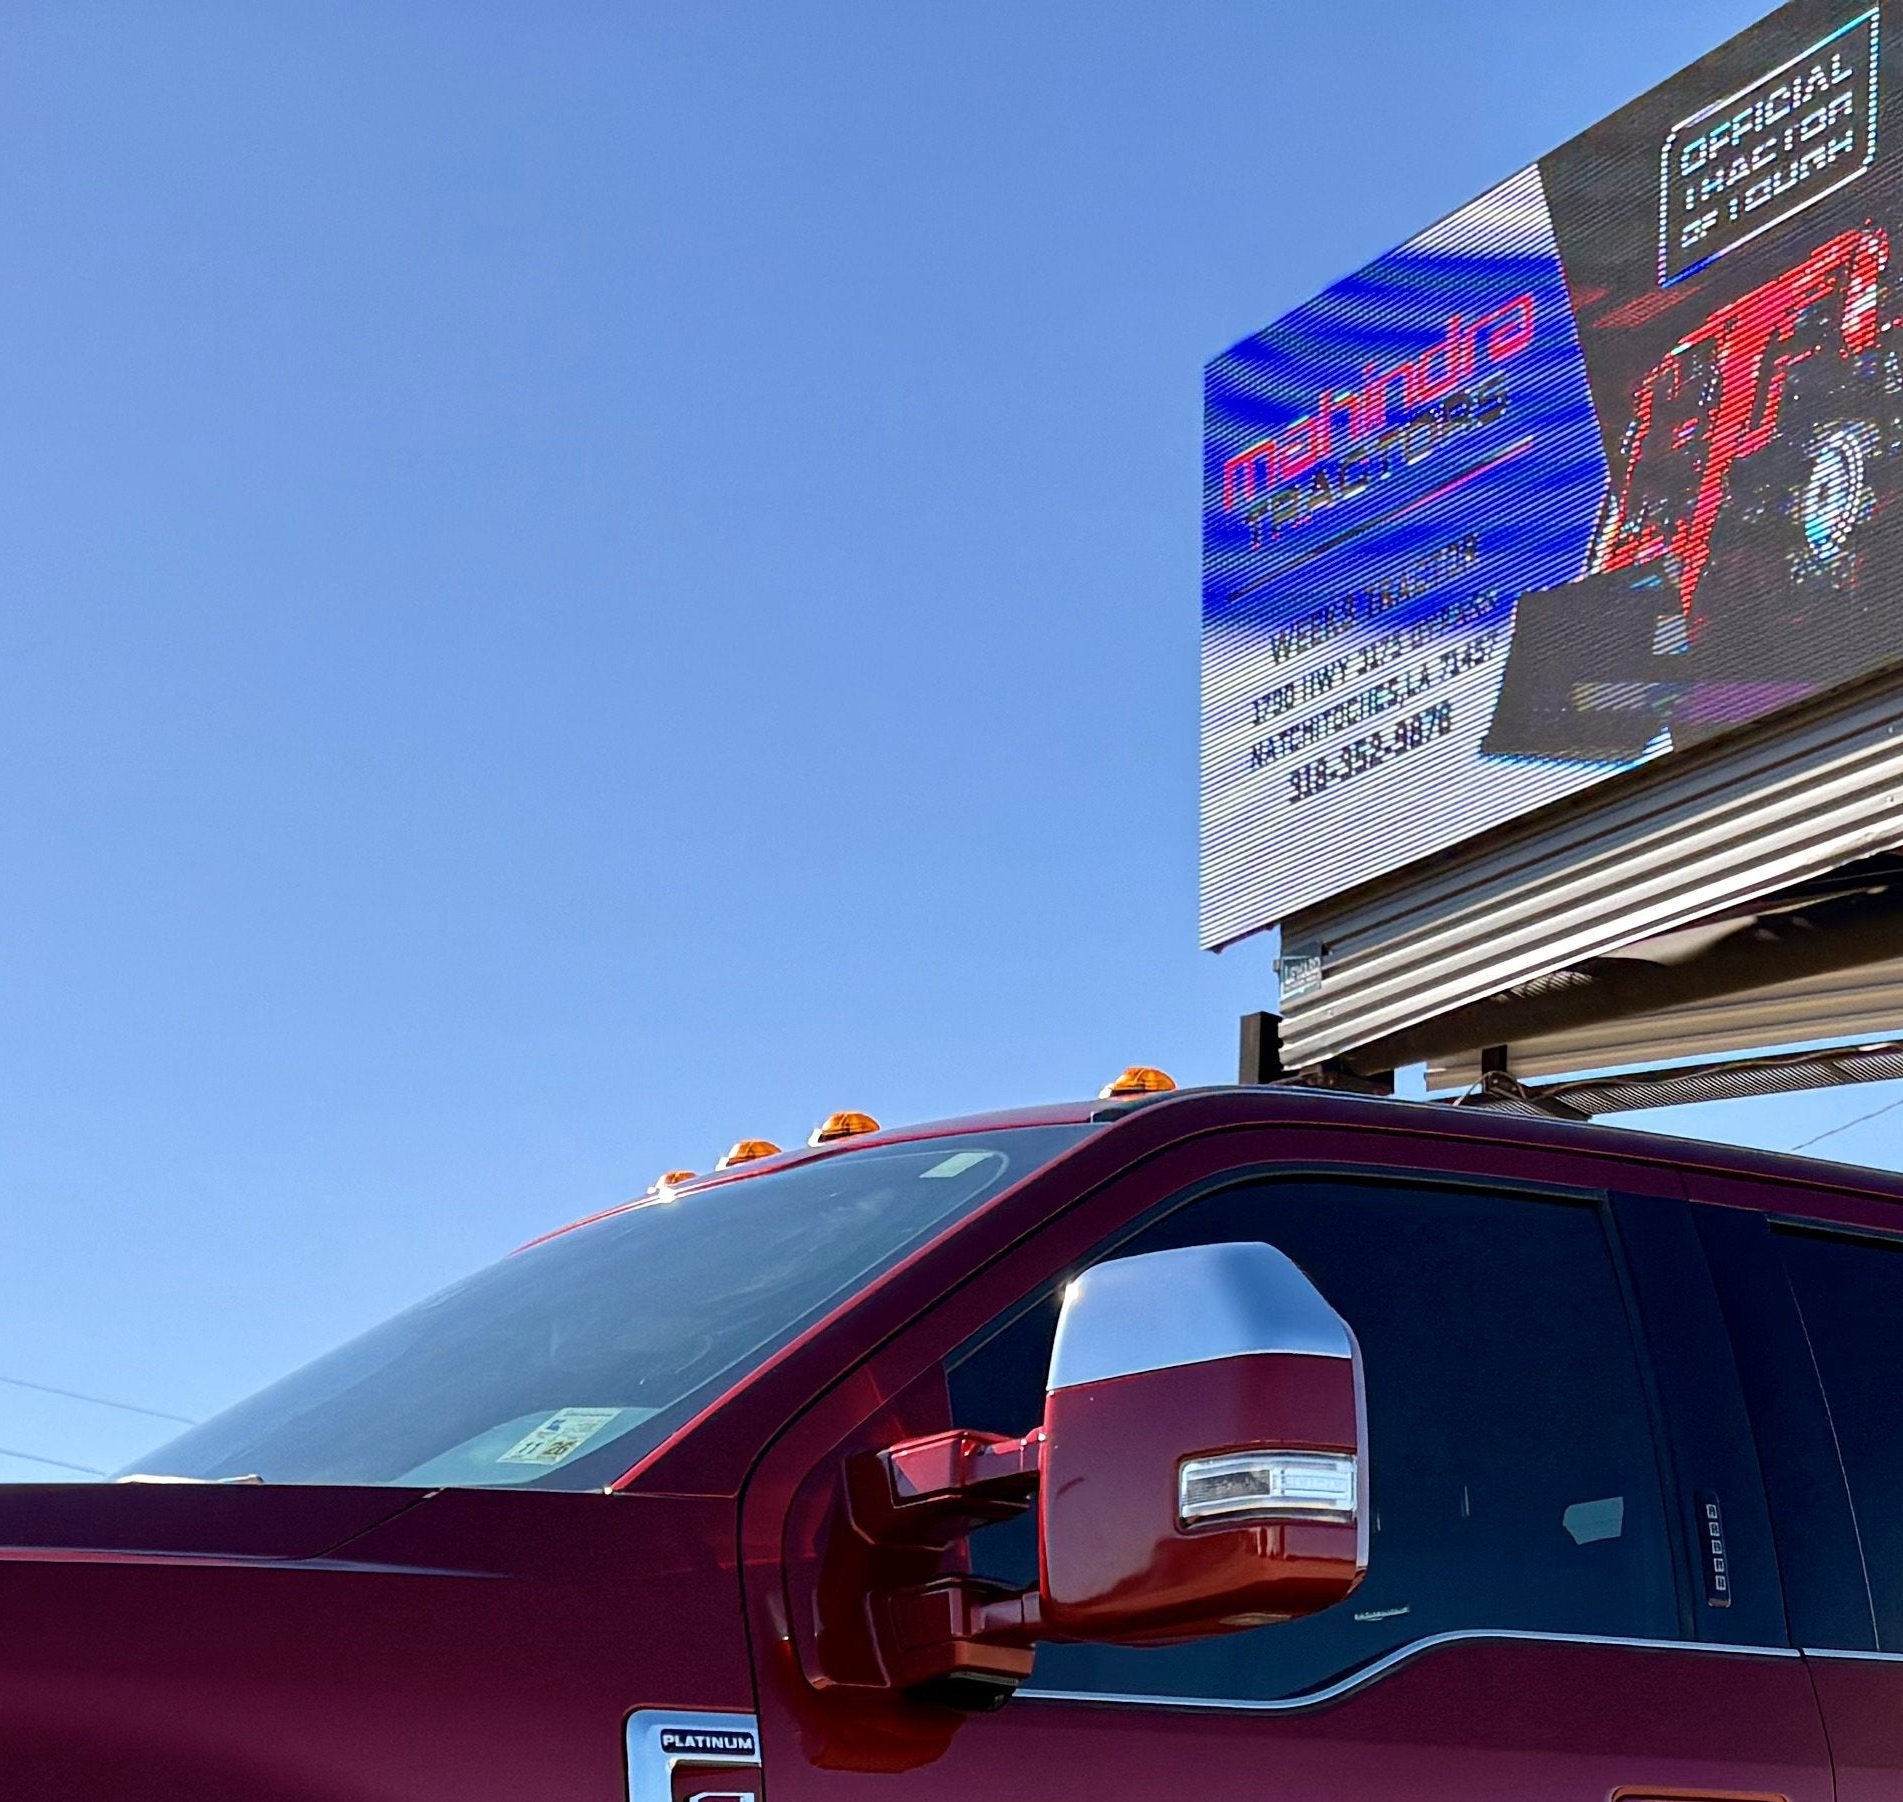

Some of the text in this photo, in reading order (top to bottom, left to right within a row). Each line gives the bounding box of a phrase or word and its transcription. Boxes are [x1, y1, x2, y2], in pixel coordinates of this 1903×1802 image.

[1681, 53, 1853, 177] OFFICIAL
[1223, 291, 1535, 512] mahindra
[1243, 369, 1511, 551] TRACTORS
[662, 1734, 753, 1749] PLATINUM
